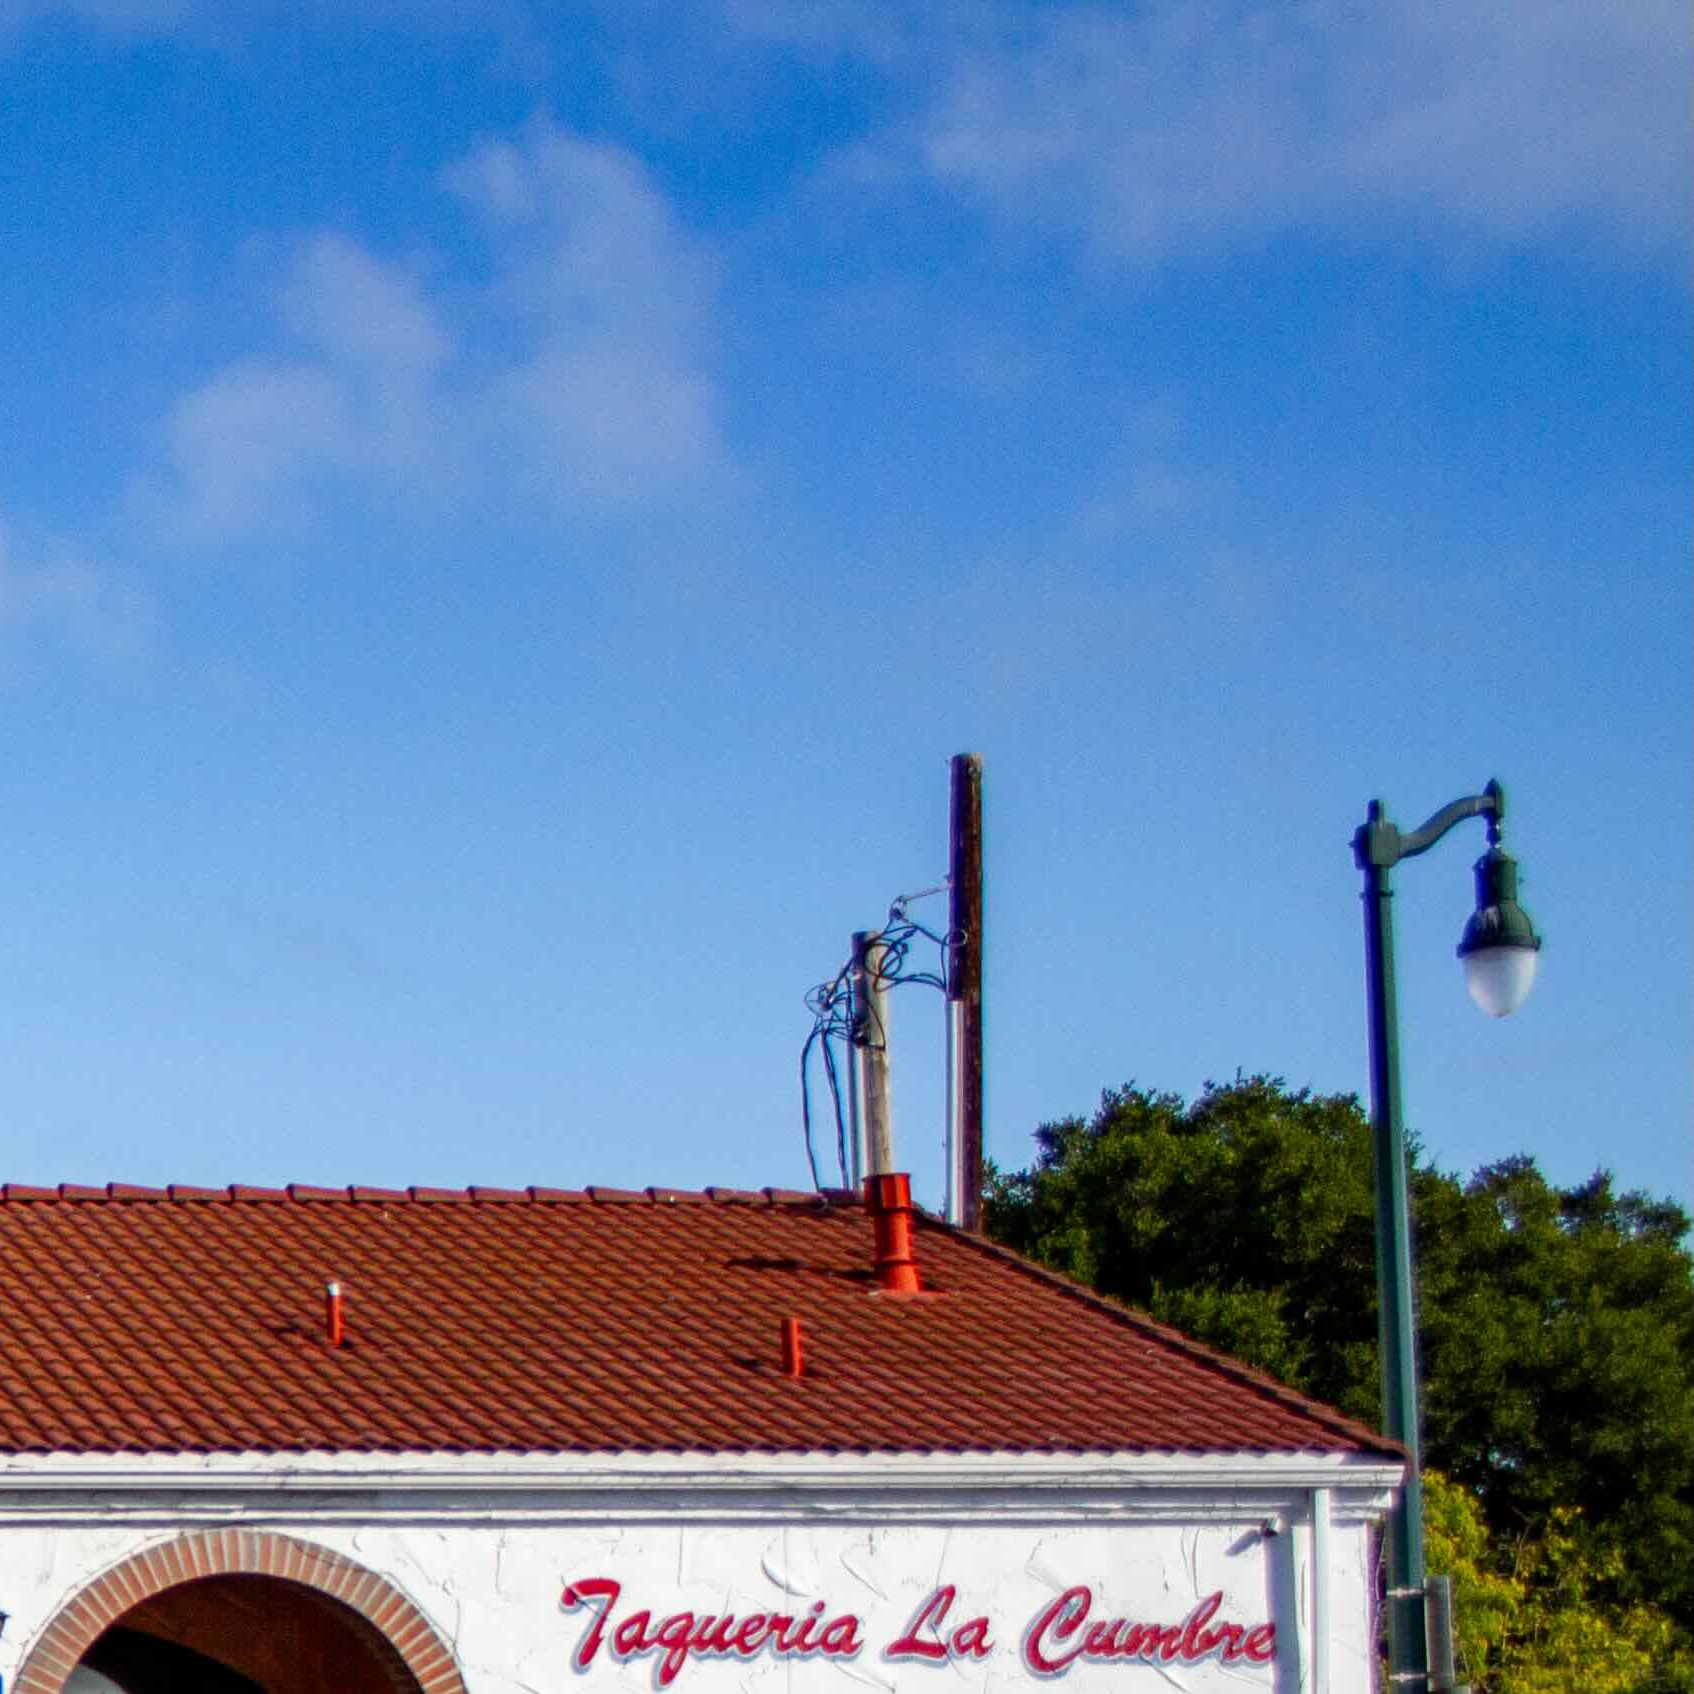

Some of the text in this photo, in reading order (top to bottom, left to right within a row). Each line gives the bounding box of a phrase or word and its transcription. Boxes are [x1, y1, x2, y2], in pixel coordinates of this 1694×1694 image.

[559, 1576, 1276, 1688] Taqueria La Cumbre
